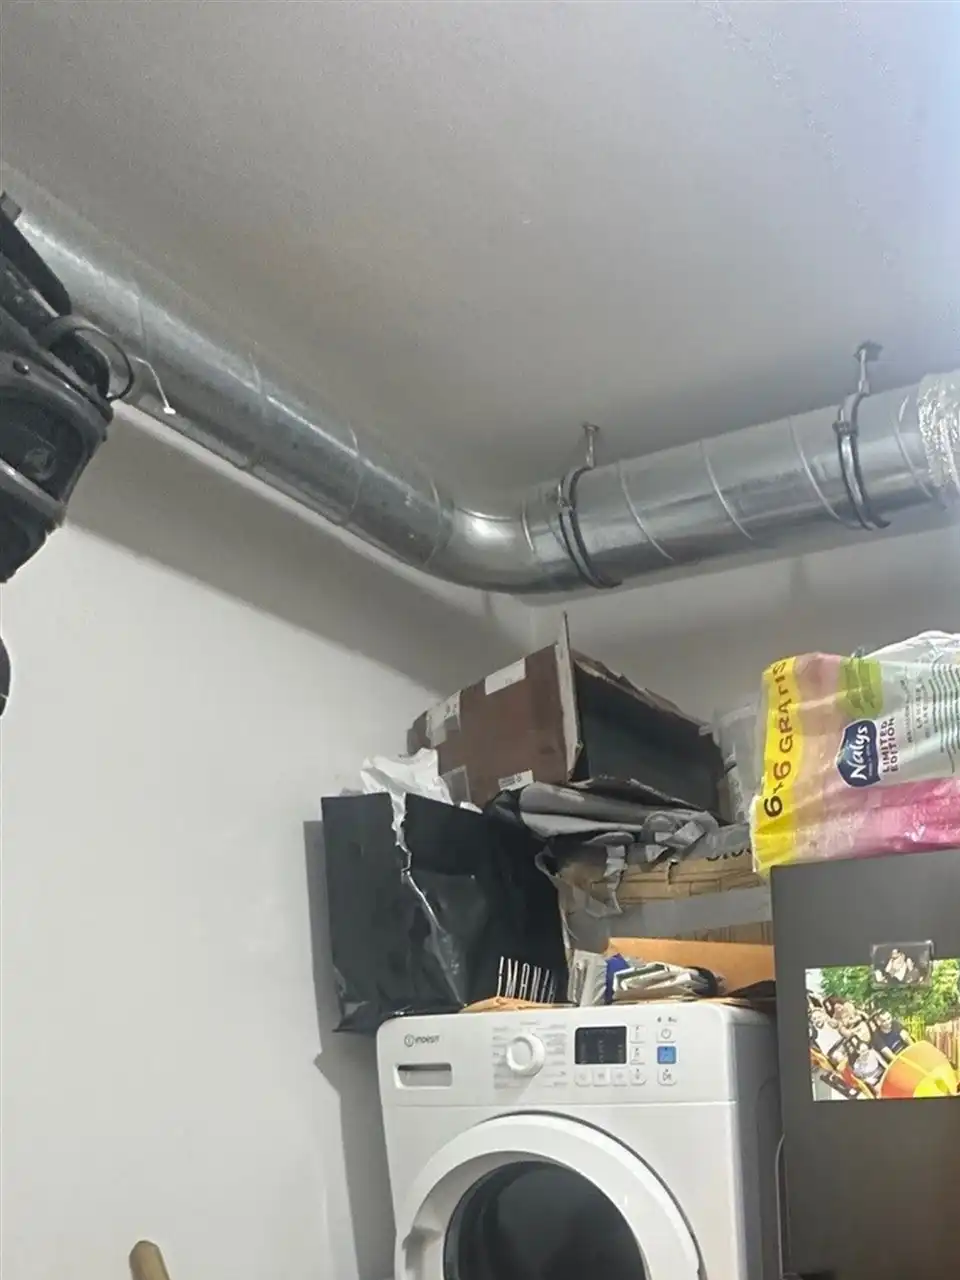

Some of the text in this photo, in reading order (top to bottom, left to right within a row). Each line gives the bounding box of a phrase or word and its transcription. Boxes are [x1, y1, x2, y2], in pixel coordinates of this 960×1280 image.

[849, 724, 870, 780] Nalys
[880, 720, 890, 774] LIMITED
[889, 717, 899, 772] EDITION
